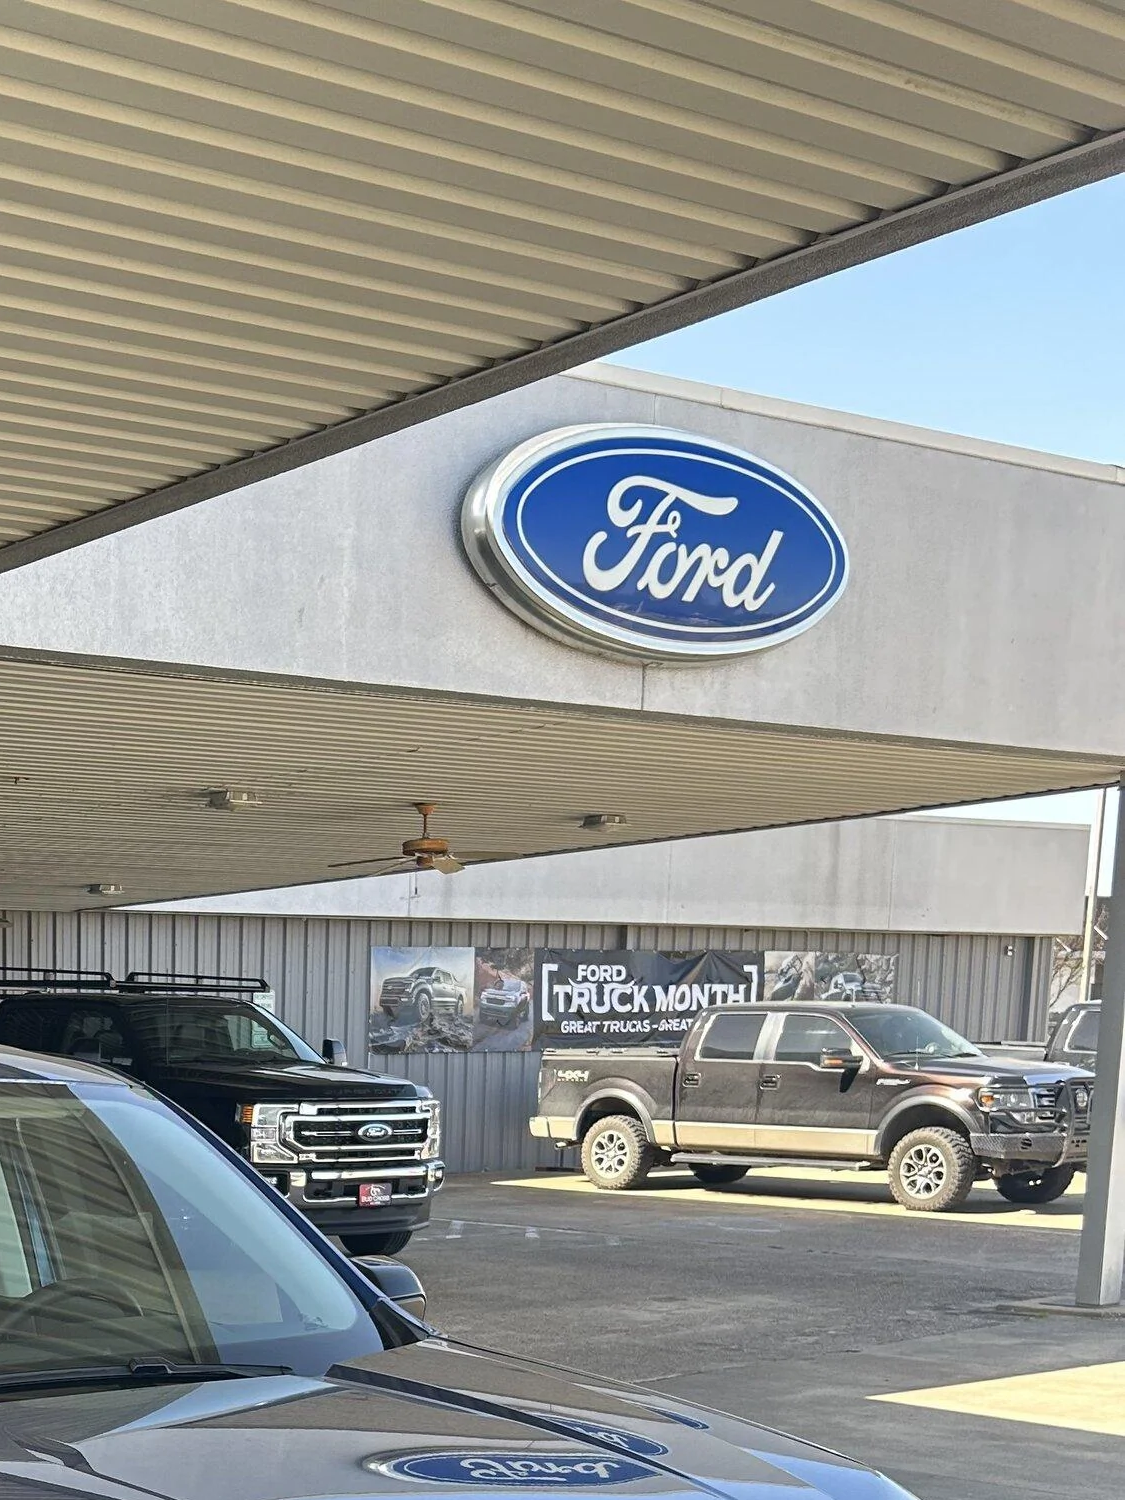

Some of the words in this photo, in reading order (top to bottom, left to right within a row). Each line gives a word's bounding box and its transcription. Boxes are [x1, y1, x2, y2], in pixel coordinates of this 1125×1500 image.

[583, 475, 784, 612] Ford
[576, 964, 627, 982] FORD
[553, 978, 650, 1013] TRUCK
[654, 984, 747, 1012] MONTH
[560, 1020, 599, 1034] GREAT
